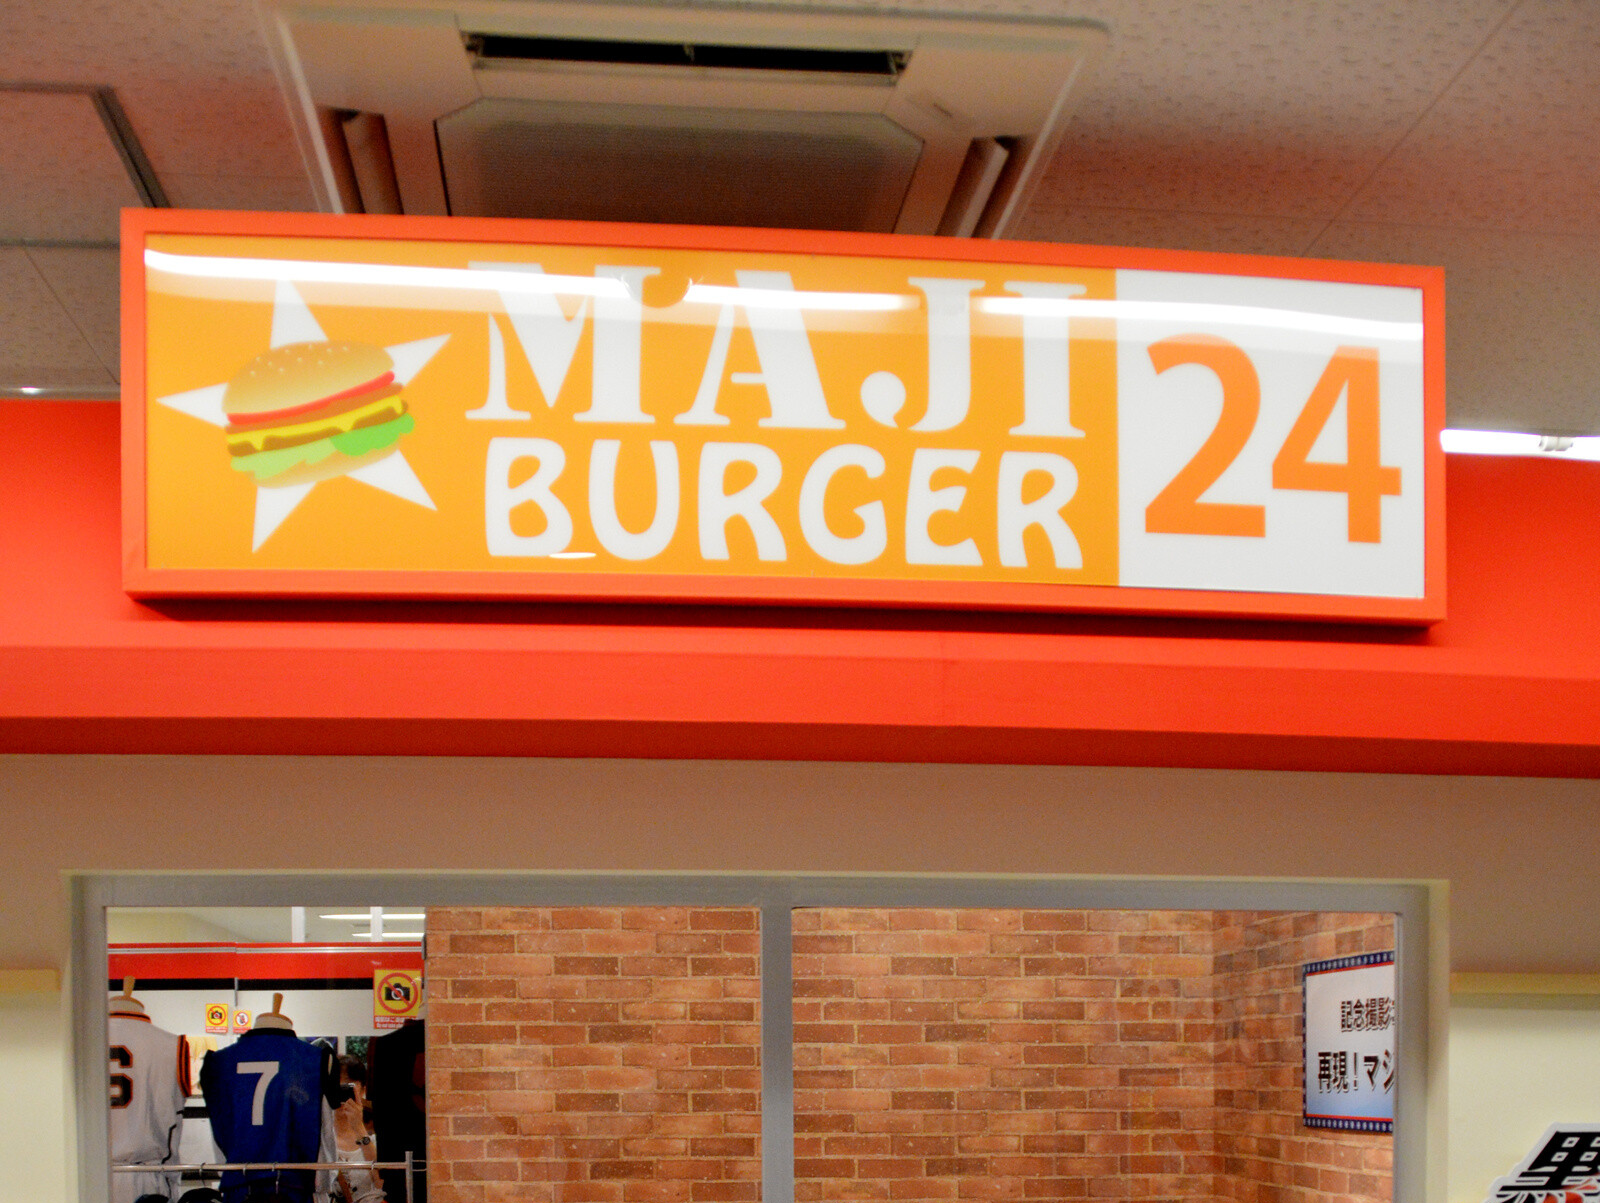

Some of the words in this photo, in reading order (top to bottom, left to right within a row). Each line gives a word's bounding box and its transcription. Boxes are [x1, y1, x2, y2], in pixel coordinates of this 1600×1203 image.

[465, 260, 1087, 438] MAJI
[484, 436, 1083, 570] BURGER
[1145, 332, 1401, 545] 24
[1340, 997, 1395, 1032] 記念撮影
[236, 1061, 280, 1126] 7
